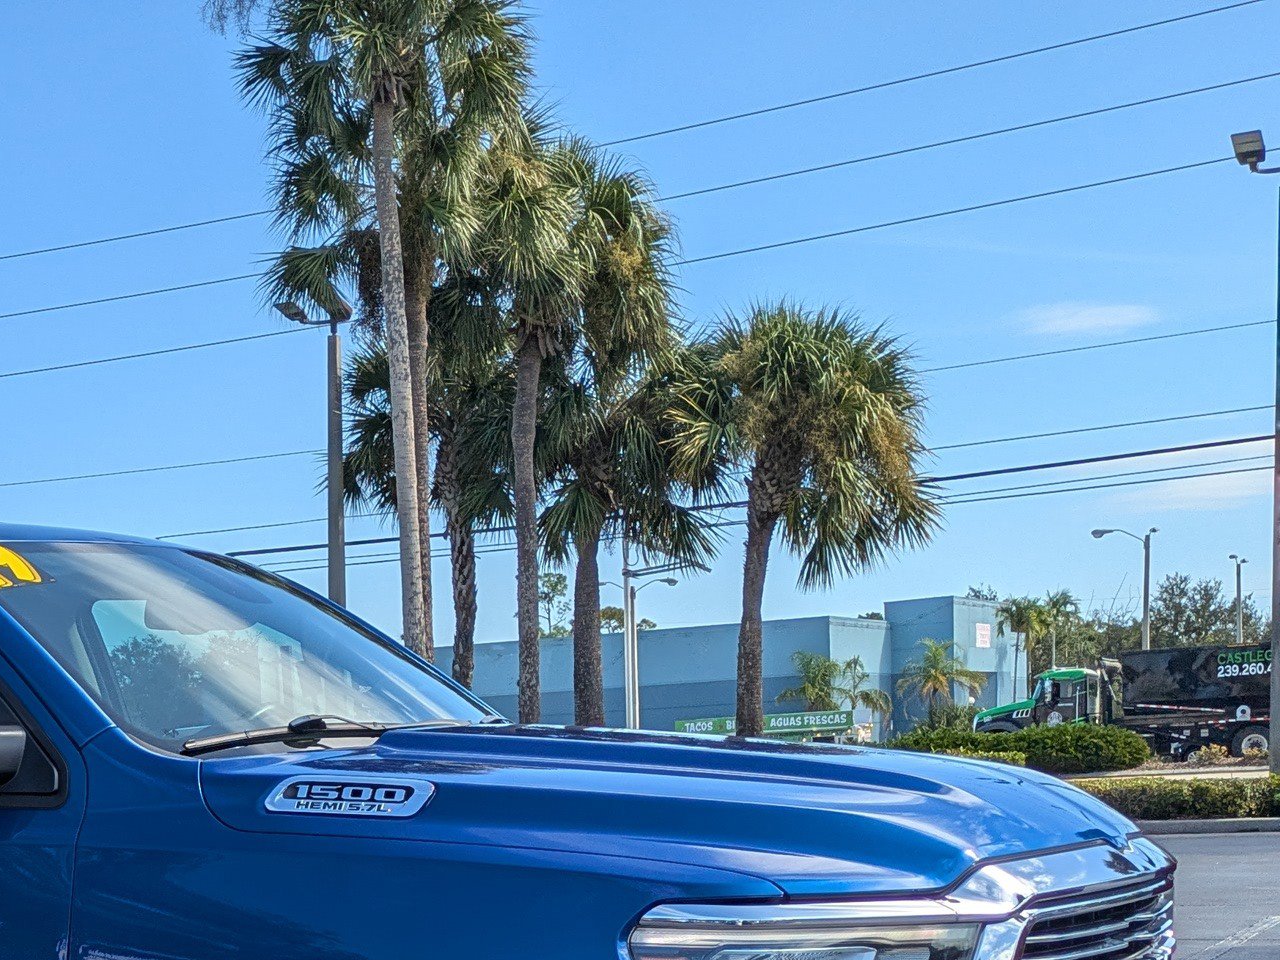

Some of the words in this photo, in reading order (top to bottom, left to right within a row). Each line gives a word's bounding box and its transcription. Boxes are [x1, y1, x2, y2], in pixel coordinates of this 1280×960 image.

[684, 721, 713, 733] TACOS
[770, 716, 802, 728] AGUAS
[803, 713, 847, 726] FRESCAS
[295, 784, 406, 802] 1500
[296, 801, 343, 812] HEMI
[348, 803, 389, 813] 5.7L
